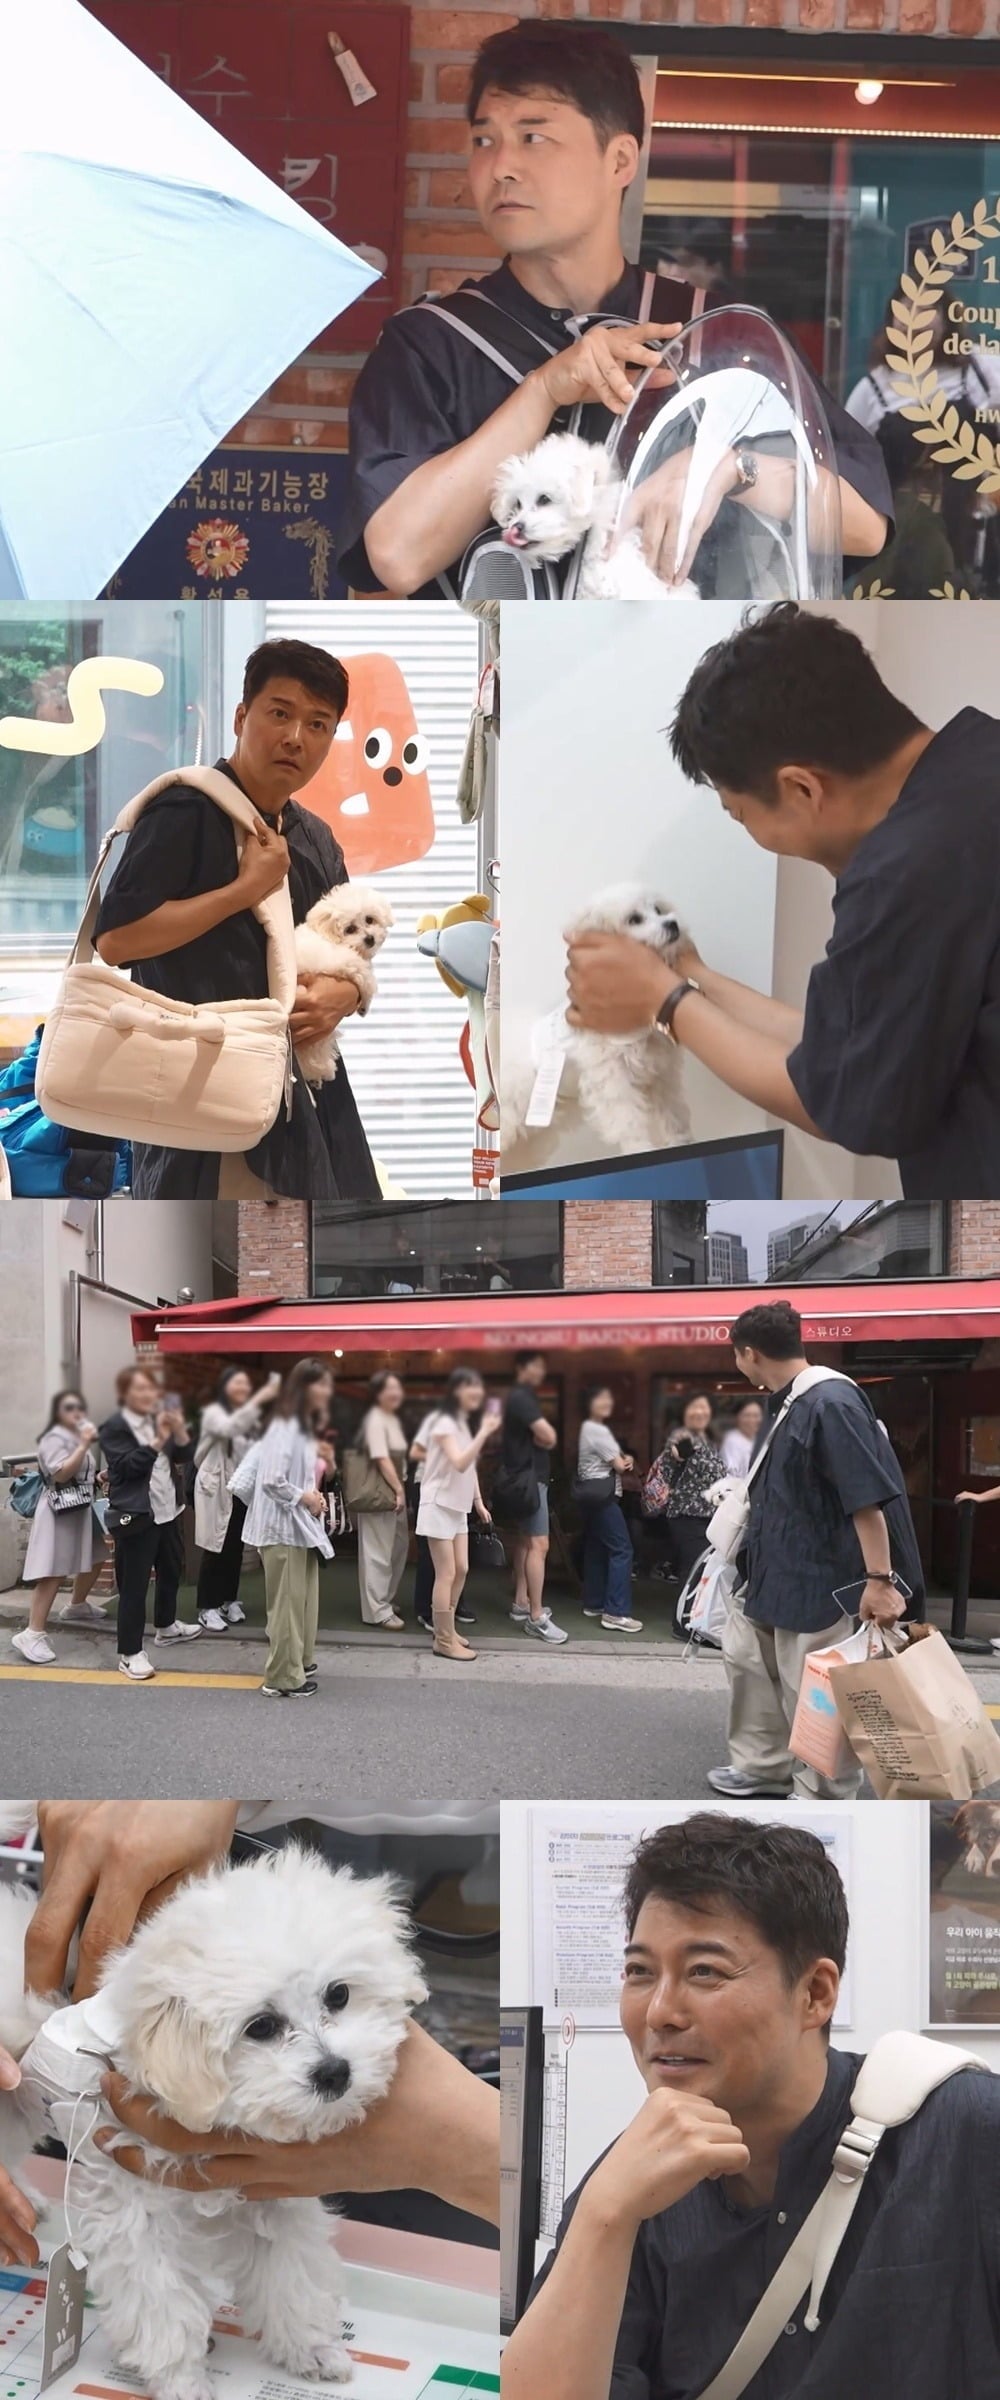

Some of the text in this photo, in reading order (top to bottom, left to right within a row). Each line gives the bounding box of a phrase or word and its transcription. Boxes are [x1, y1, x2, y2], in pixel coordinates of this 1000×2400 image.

[943, 332, 974, 356] de
[195, 496, 254, 511] Master
[260, 499, 311, 514] Baker
[655, 1326, 730, 1343] STUDIO
[804, 1325, 852, 1338] 스튜디오
[945, 1926, 963, 1938] 우리
[965, 1926, 983, 1938] 아이
